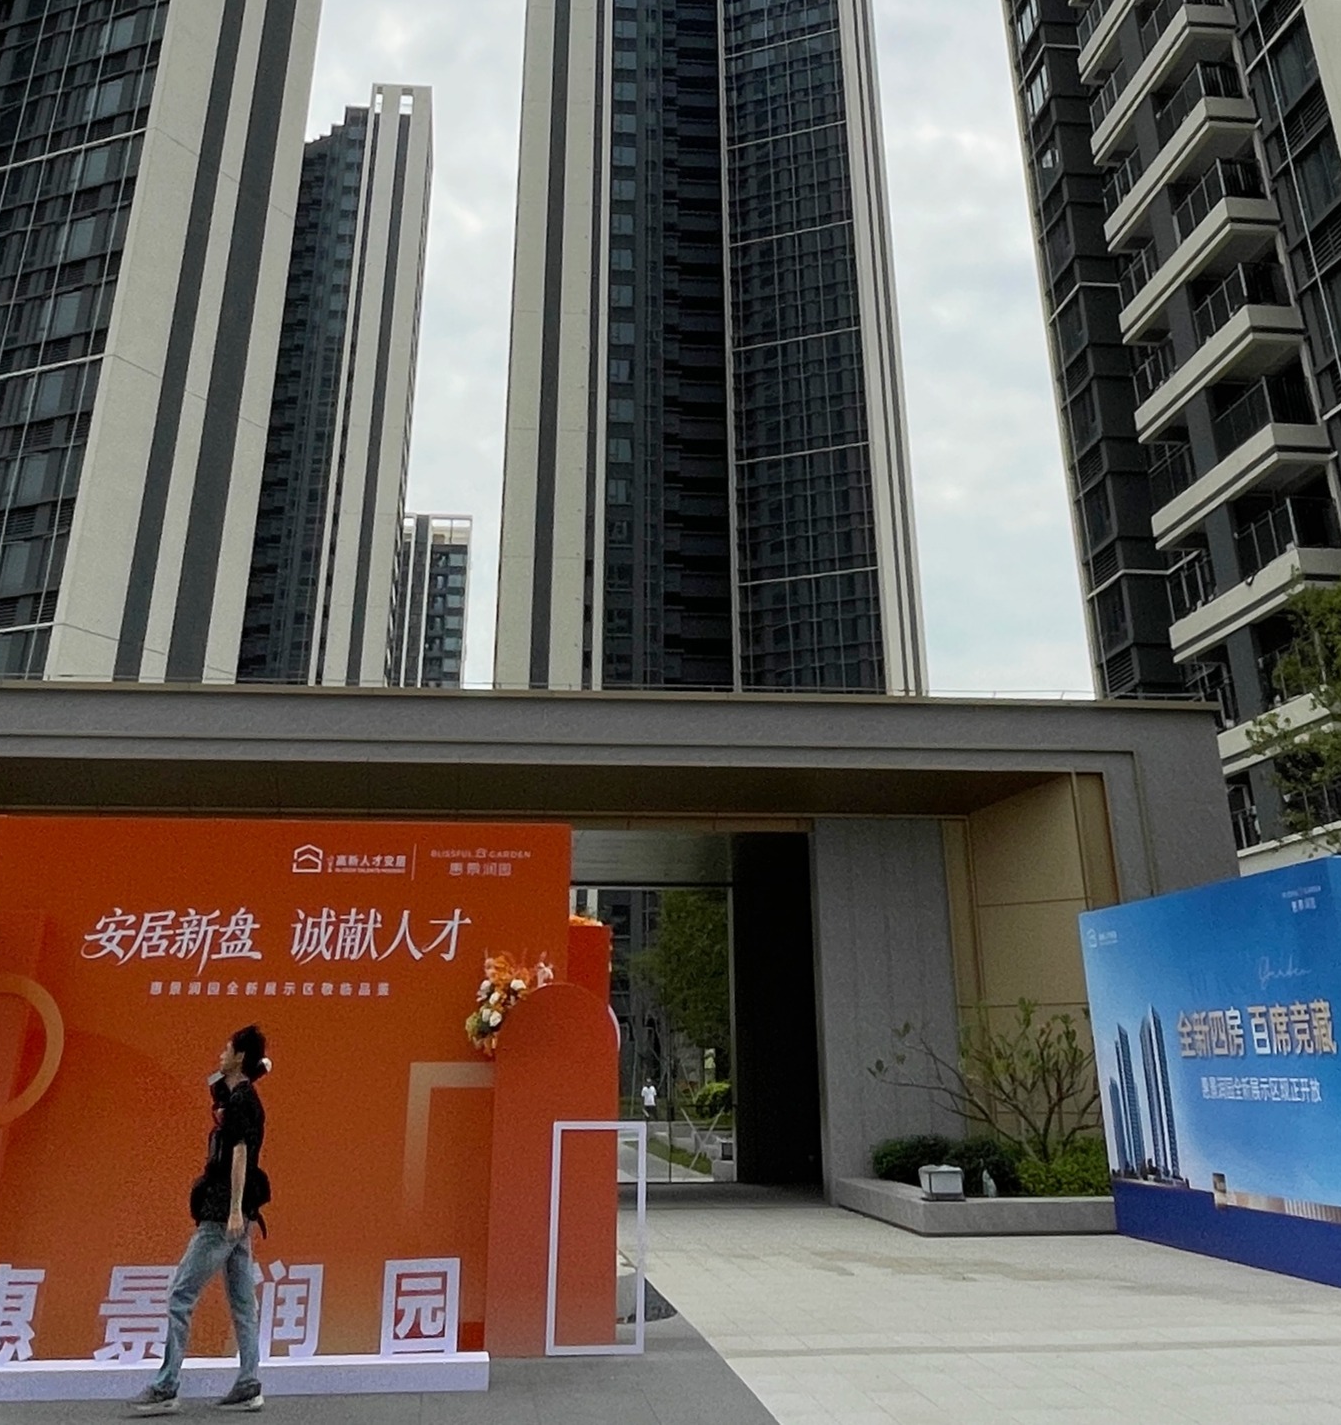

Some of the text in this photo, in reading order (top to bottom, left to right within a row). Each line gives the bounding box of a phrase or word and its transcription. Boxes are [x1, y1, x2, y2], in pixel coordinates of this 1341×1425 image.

[335, 854, 407, 867] 高新人才安居
[430, 848, 532, 859] BLISSFUL GARDEN
[81, 906, 472, 976] 安居新盘 诚献人才
[1177, 997, 1338, 1058] 全新四房 百席竞藏
